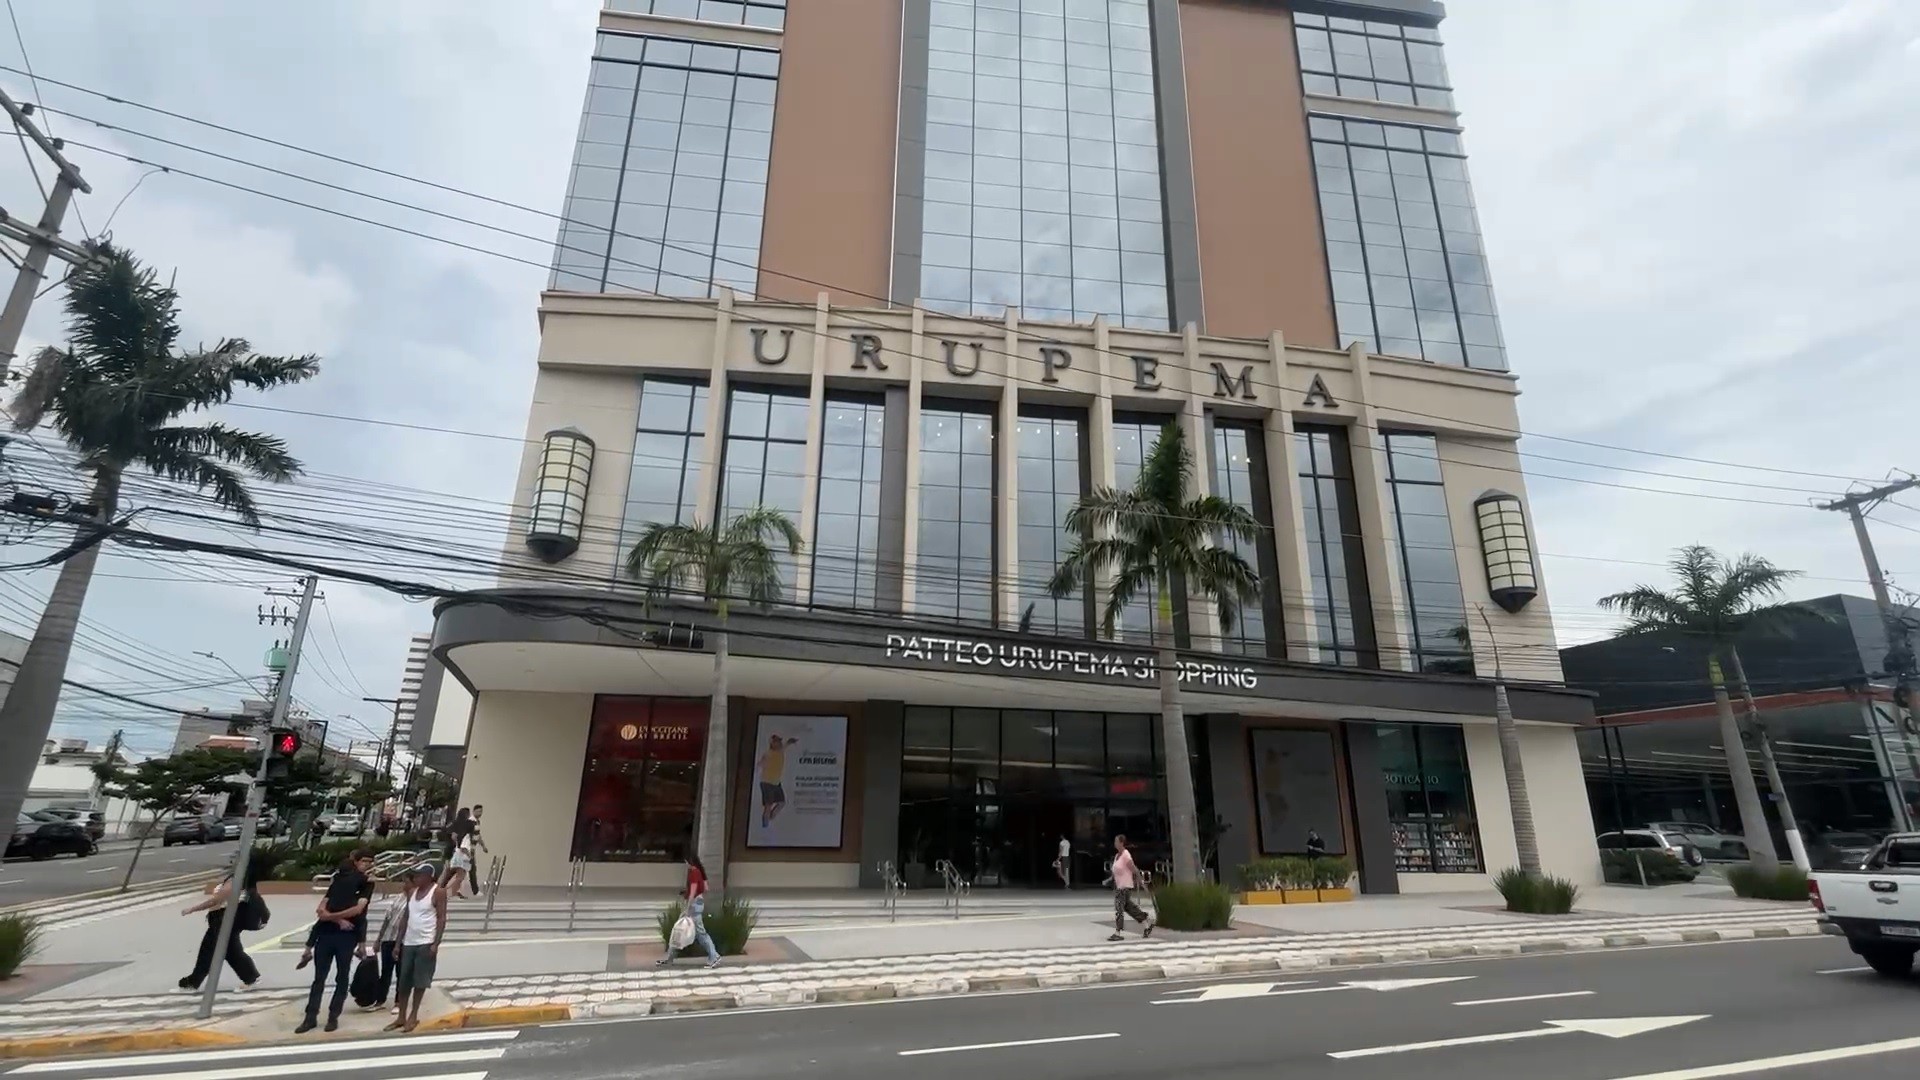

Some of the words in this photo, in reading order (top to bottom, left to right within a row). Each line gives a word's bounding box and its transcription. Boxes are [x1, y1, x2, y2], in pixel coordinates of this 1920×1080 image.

[750, 328, 1340, 407] URUPEMA
[884, 634, 994, 665] PATTEO
[998, 645, 1129, 678] URUPEMA
[638, 726, 689, 735] L'CCITANE
[1384, 772, 1440, 785] BOTICAIO
